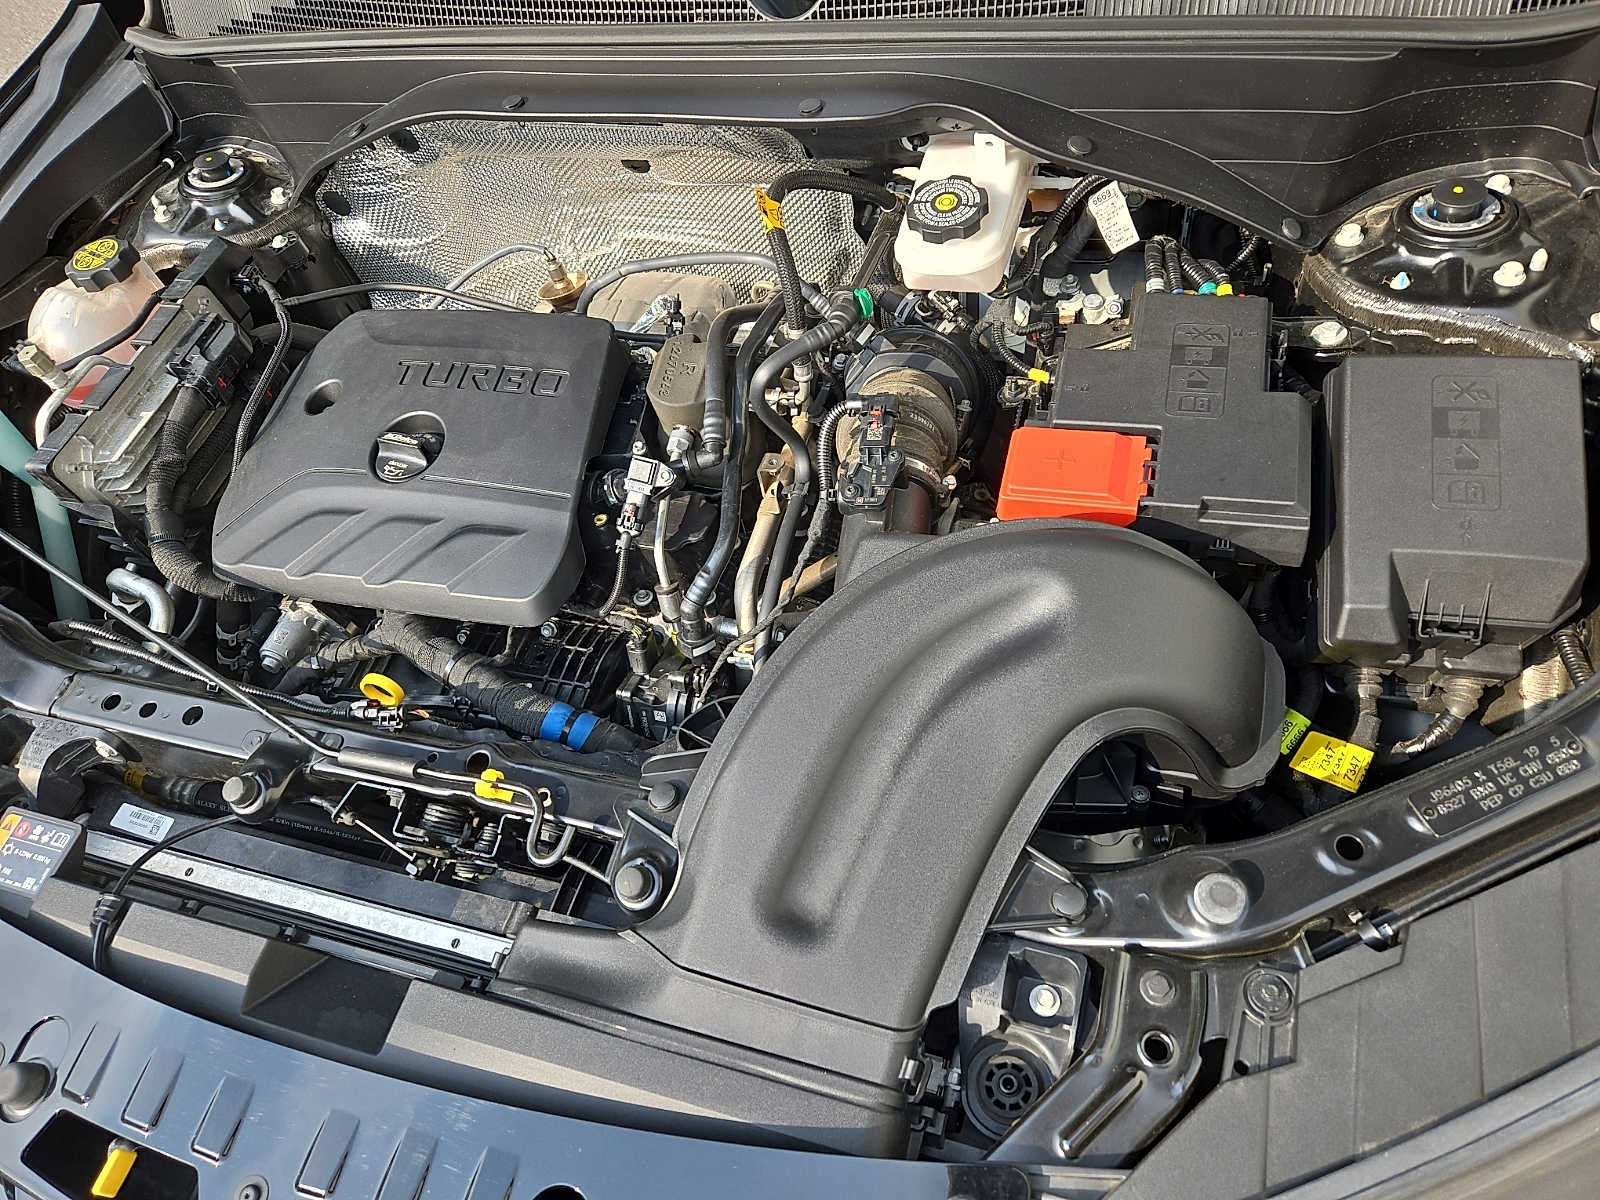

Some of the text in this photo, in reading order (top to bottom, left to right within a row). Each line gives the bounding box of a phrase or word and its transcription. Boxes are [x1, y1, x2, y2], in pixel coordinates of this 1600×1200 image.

[398, 360, 571, 398] TURBO
[1522, 745, 1540, 759] 19
[1343, 756, 1361, 782] 7347
[1479, 793, 1504, 811] PEP
[1508, 784, 1525, 798] CP
